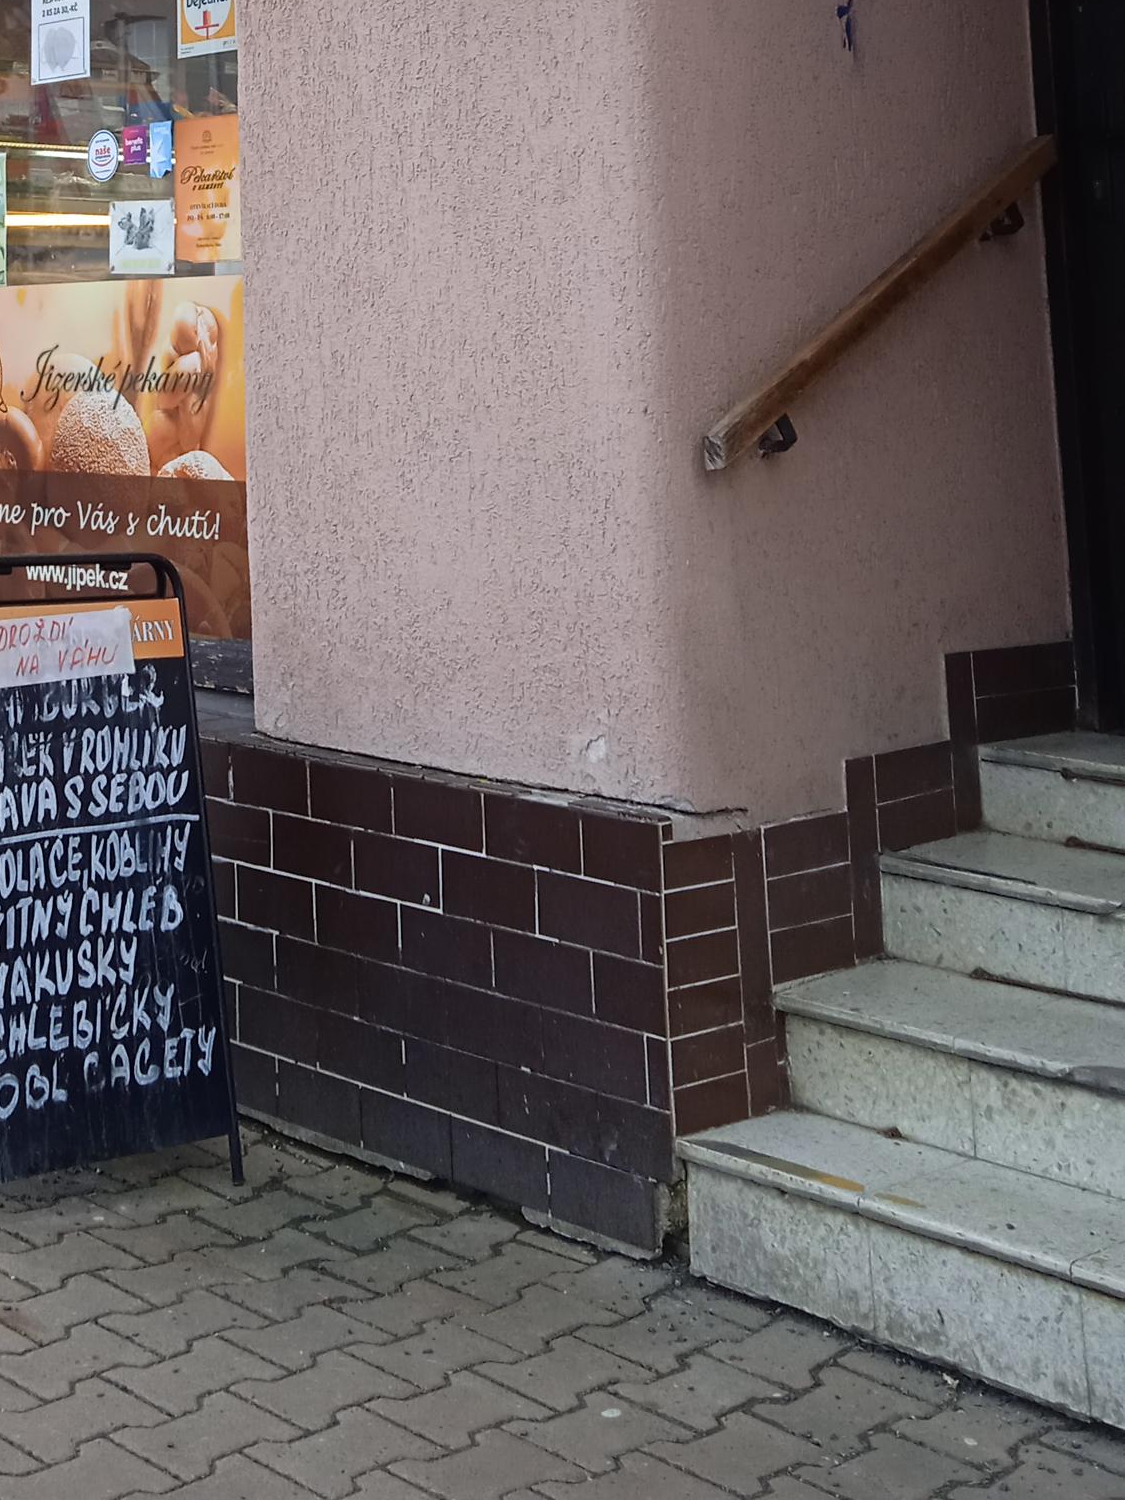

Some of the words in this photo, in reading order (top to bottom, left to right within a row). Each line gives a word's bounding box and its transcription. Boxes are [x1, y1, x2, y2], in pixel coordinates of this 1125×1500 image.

[20, 344, 121, 410] Jizerské
[113, 356, 215, 415] pekárny
[30, 502, 71, 536] pro
[76, 500, 120, 536] Vás
[126, 514, 139, 536] s
[146, 504, 221, 540] chutí!
[26, 563, 129, 592] www.jipek.cz
[16, 653, 40, 677] NA
[57, 639, 118, 673] VÁHU
